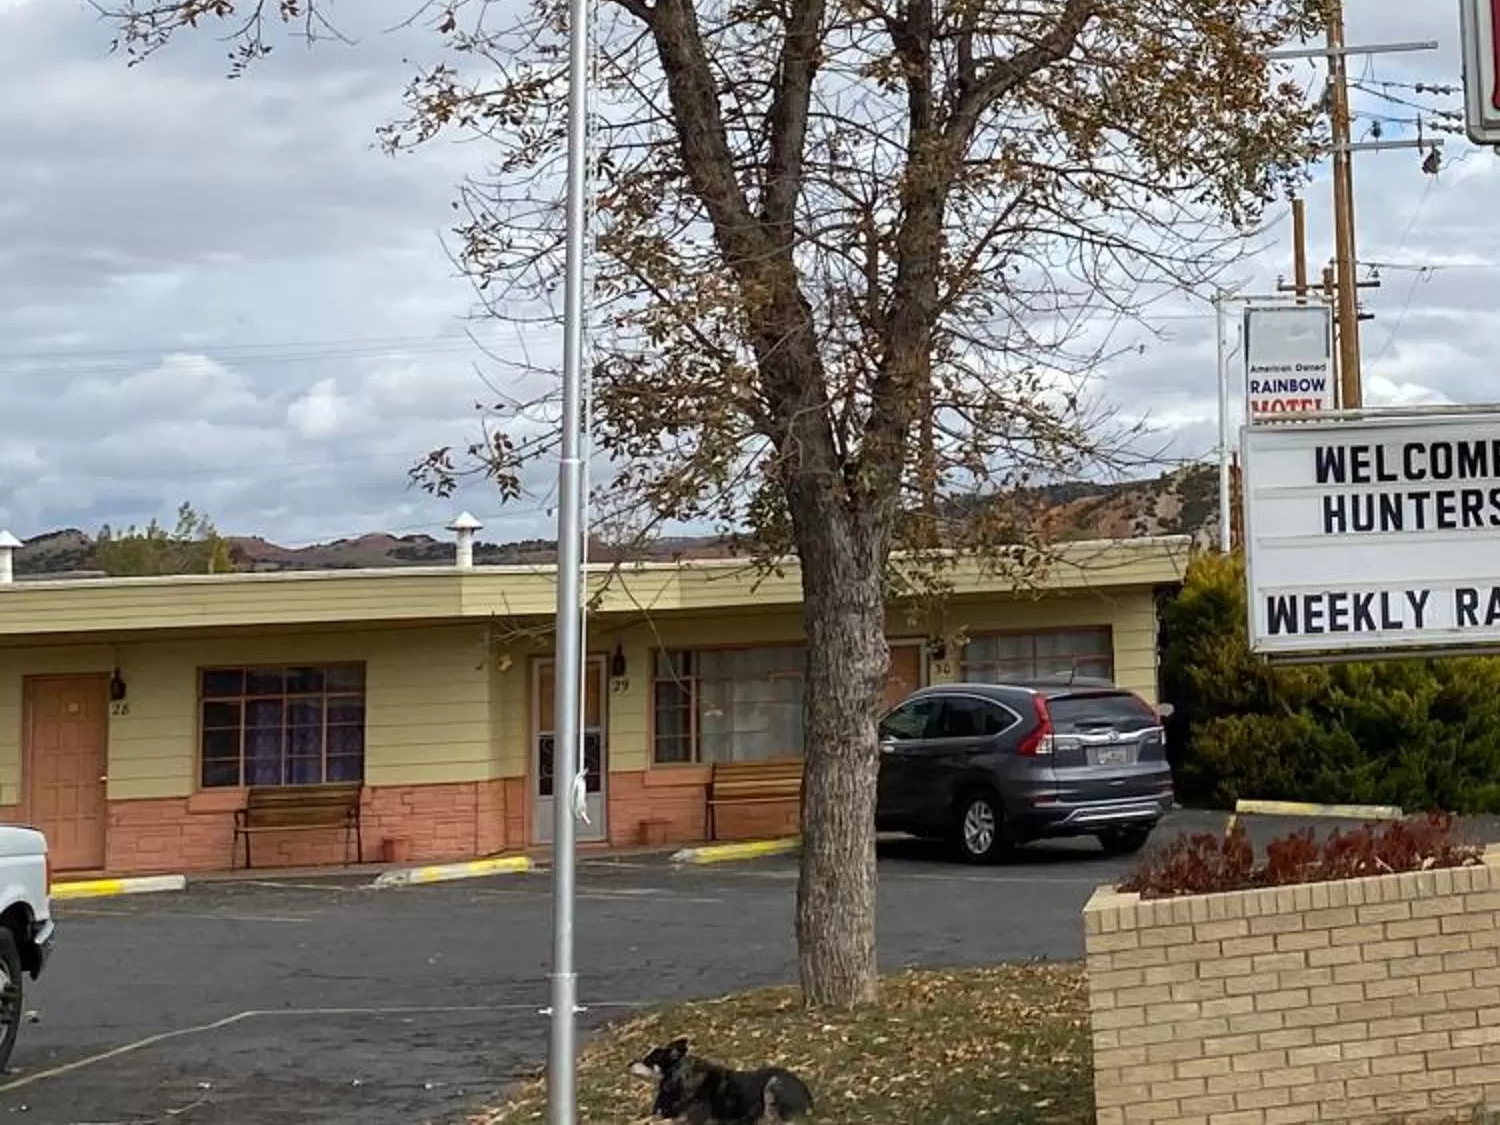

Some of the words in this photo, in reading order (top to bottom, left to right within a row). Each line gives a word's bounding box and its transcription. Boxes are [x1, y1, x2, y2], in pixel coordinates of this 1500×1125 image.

[1250, 364, 1292, 373] American
[1295, 362, 1327, 372] Owned
[1250, 378, 1326, 394] RAINBOW
[1266, 589, 1431, 636] WEEKLY
